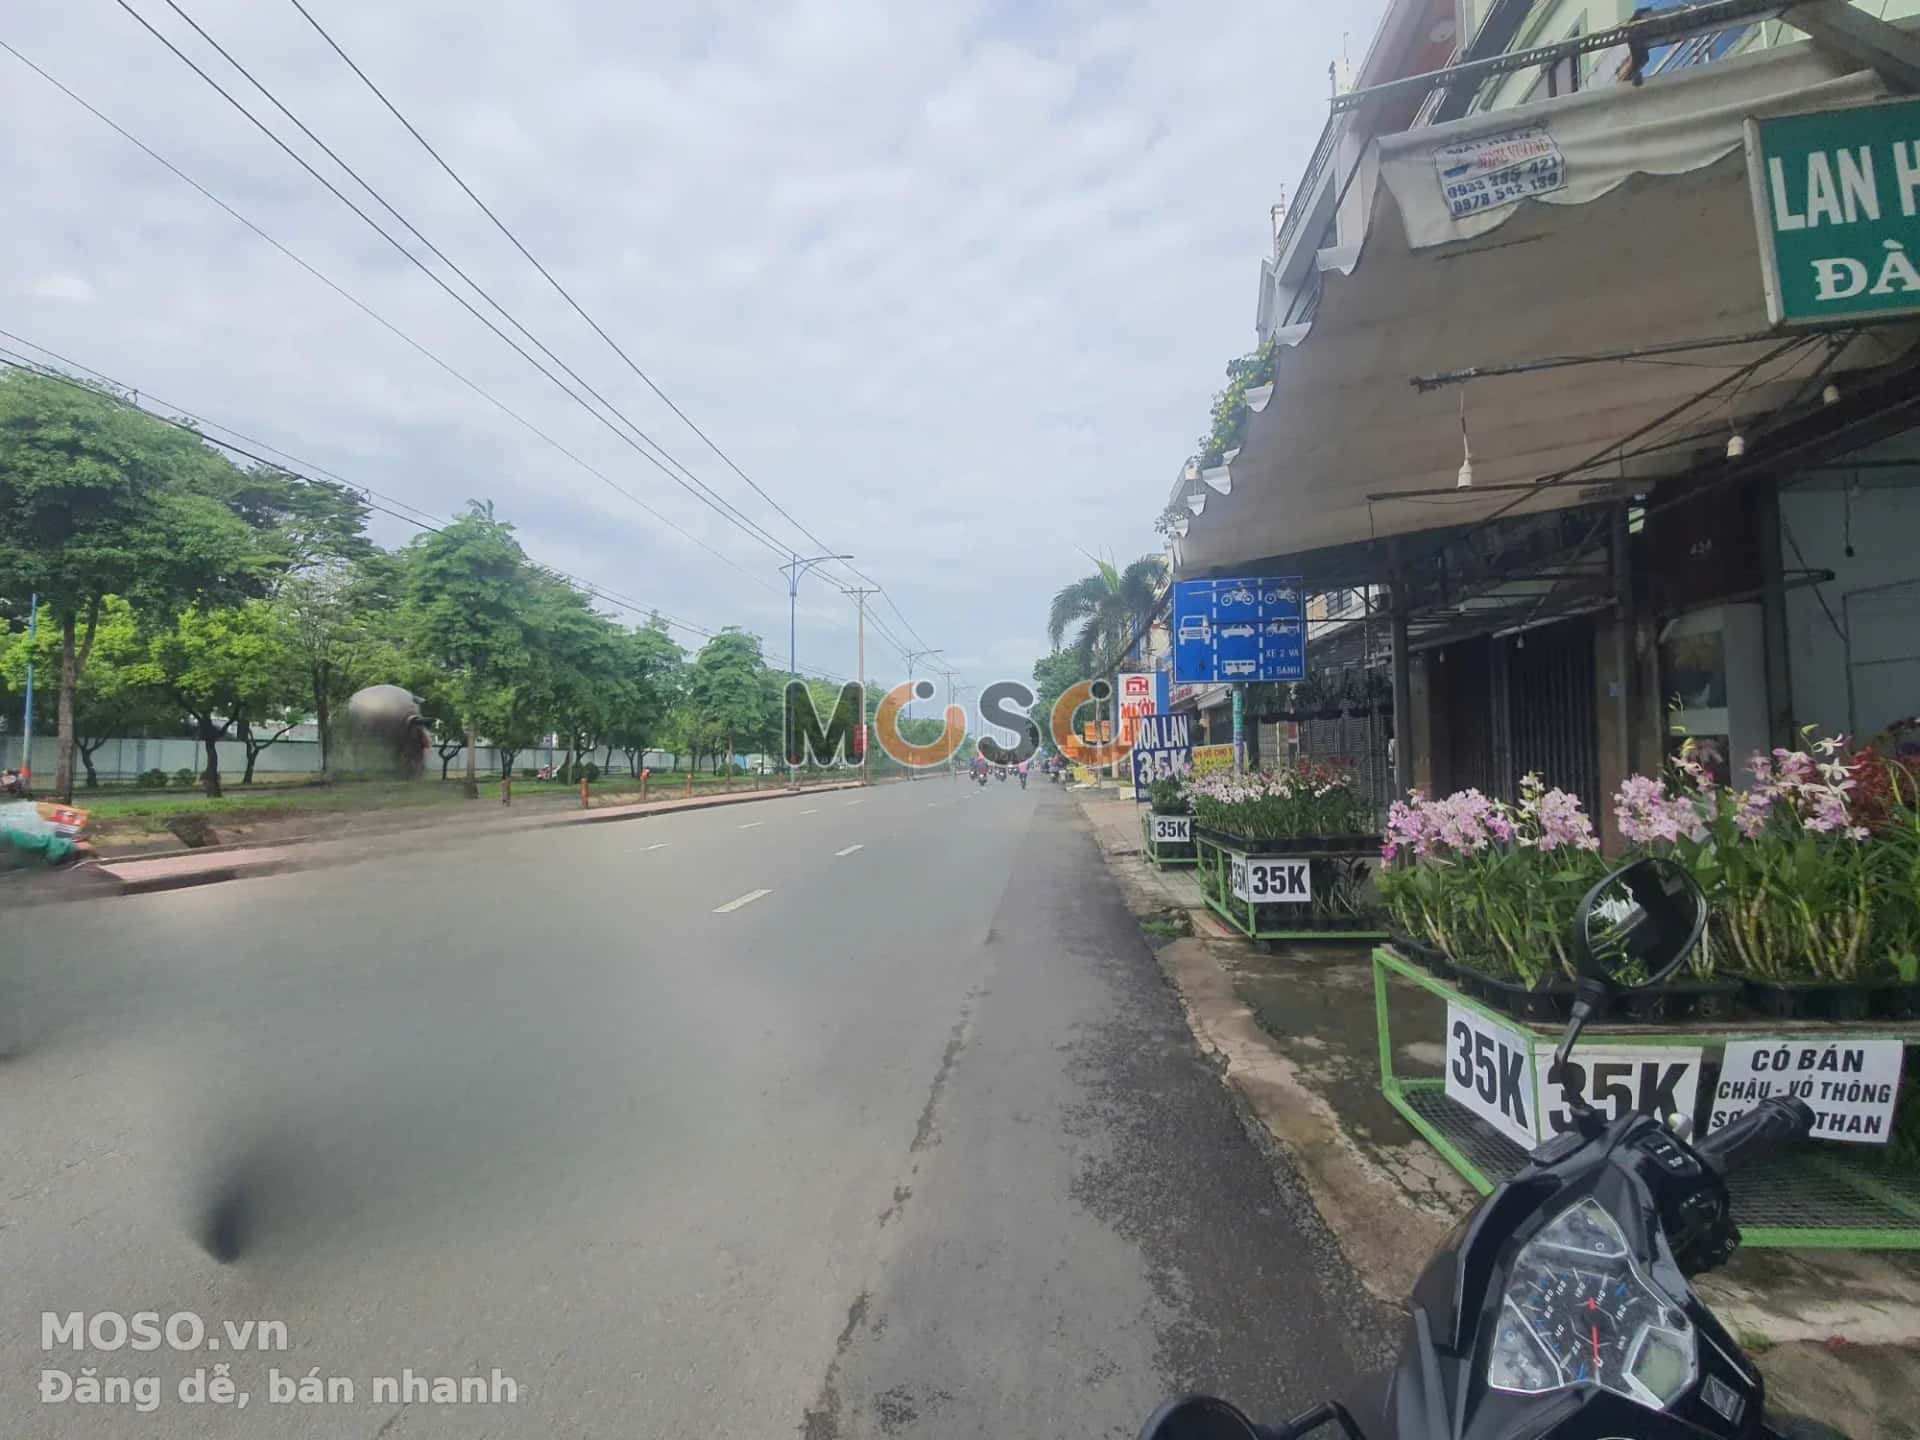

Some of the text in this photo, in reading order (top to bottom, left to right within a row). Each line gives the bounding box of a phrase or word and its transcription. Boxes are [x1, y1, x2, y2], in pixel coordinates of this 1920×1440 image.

[1768, 145, 1880, 231] LAN
[1162, 714, 1189, 748] LAN
[1137, 749, 1187, 784] 35K
[1157, 821, 1187, 838] 35K
[1252, 866, 1307, 895] 35K
[1752, 1044, 1864, 1072] CÓ BÁN
[1453, 1020, 1528, 1129] 35K
[1718, 1077, 1772, 1103] CHẬU
[1821, 1079, 1892, 1103] THÔNG
[1548, 1062, 1690, 1133] 35K
[1816, 1111, 1882, 1134] THAN
